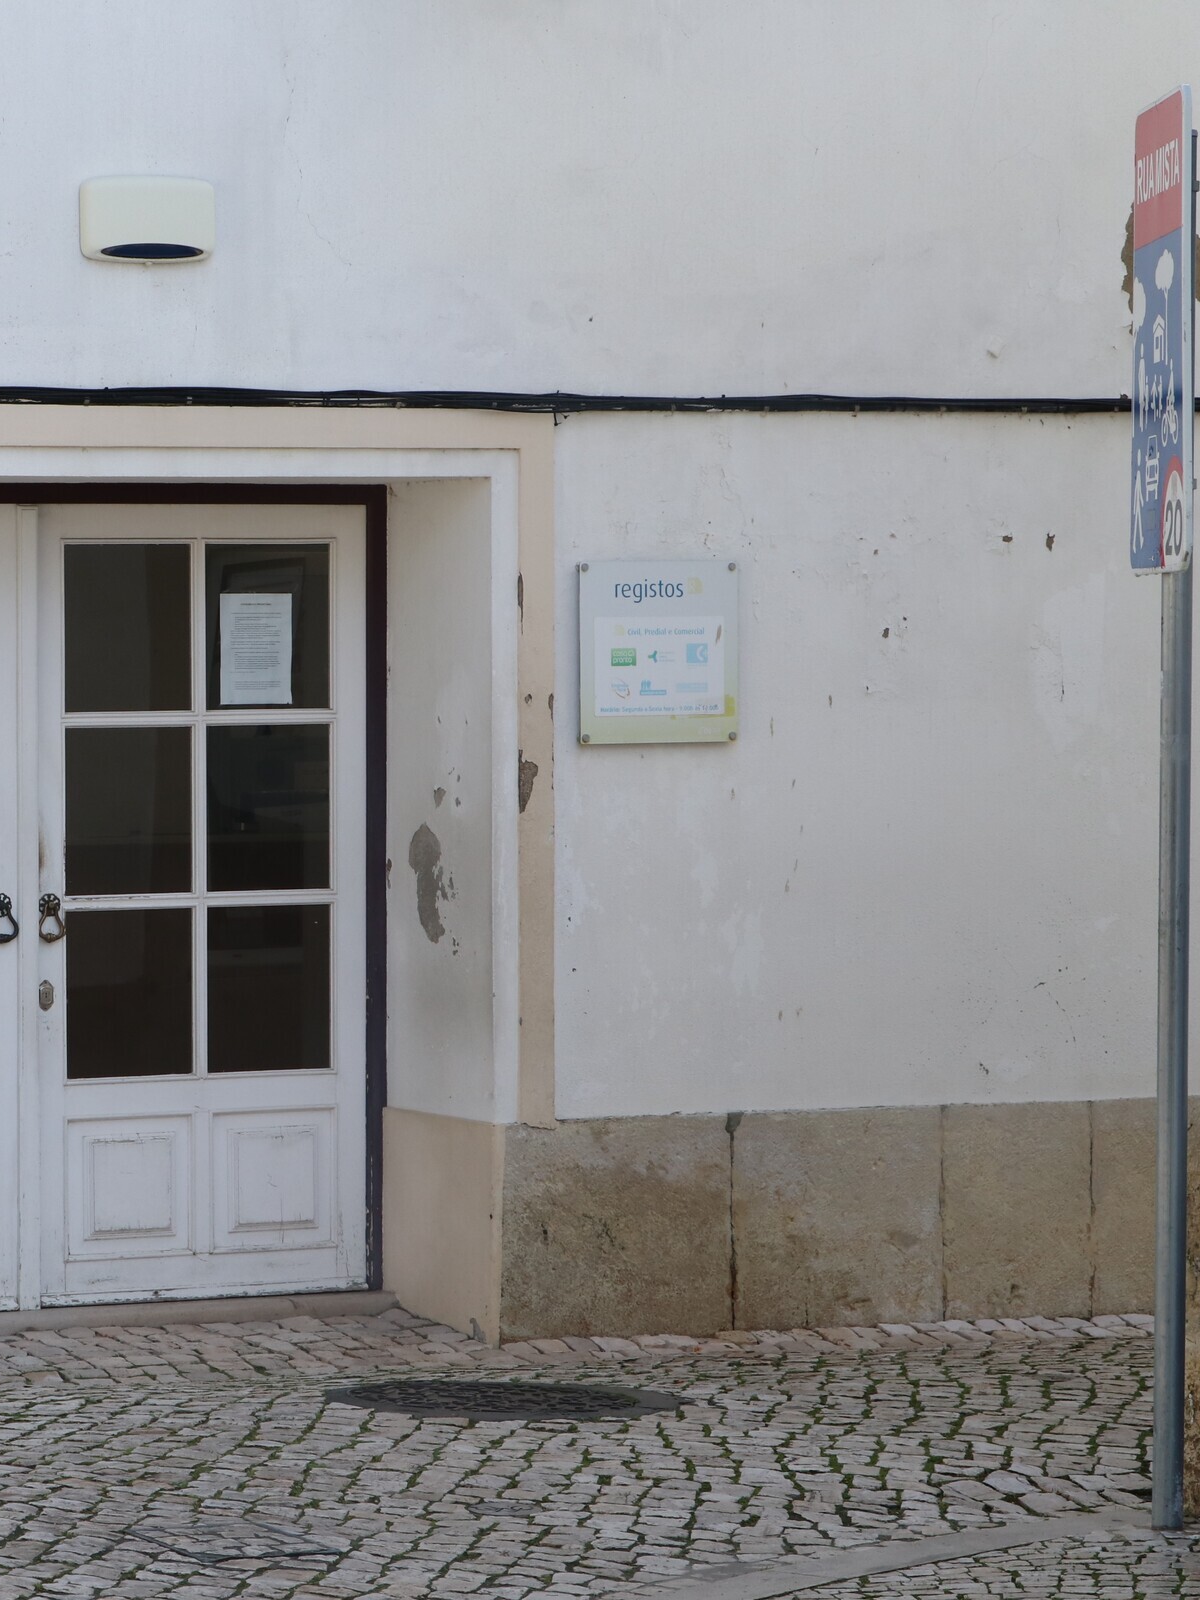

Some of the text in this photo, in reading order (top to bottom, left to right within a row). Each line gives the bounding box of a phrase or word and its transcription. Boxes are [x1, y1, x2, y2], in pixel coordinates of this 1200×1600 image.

[1136, 138, 1180, 205] RUA MISTA
[1165, 499, 1183, 556] 20
[614, 578, 684, 604] registos
[644, 627, 667, 636] Predial
[674, 627, 705, 636] Comercial
